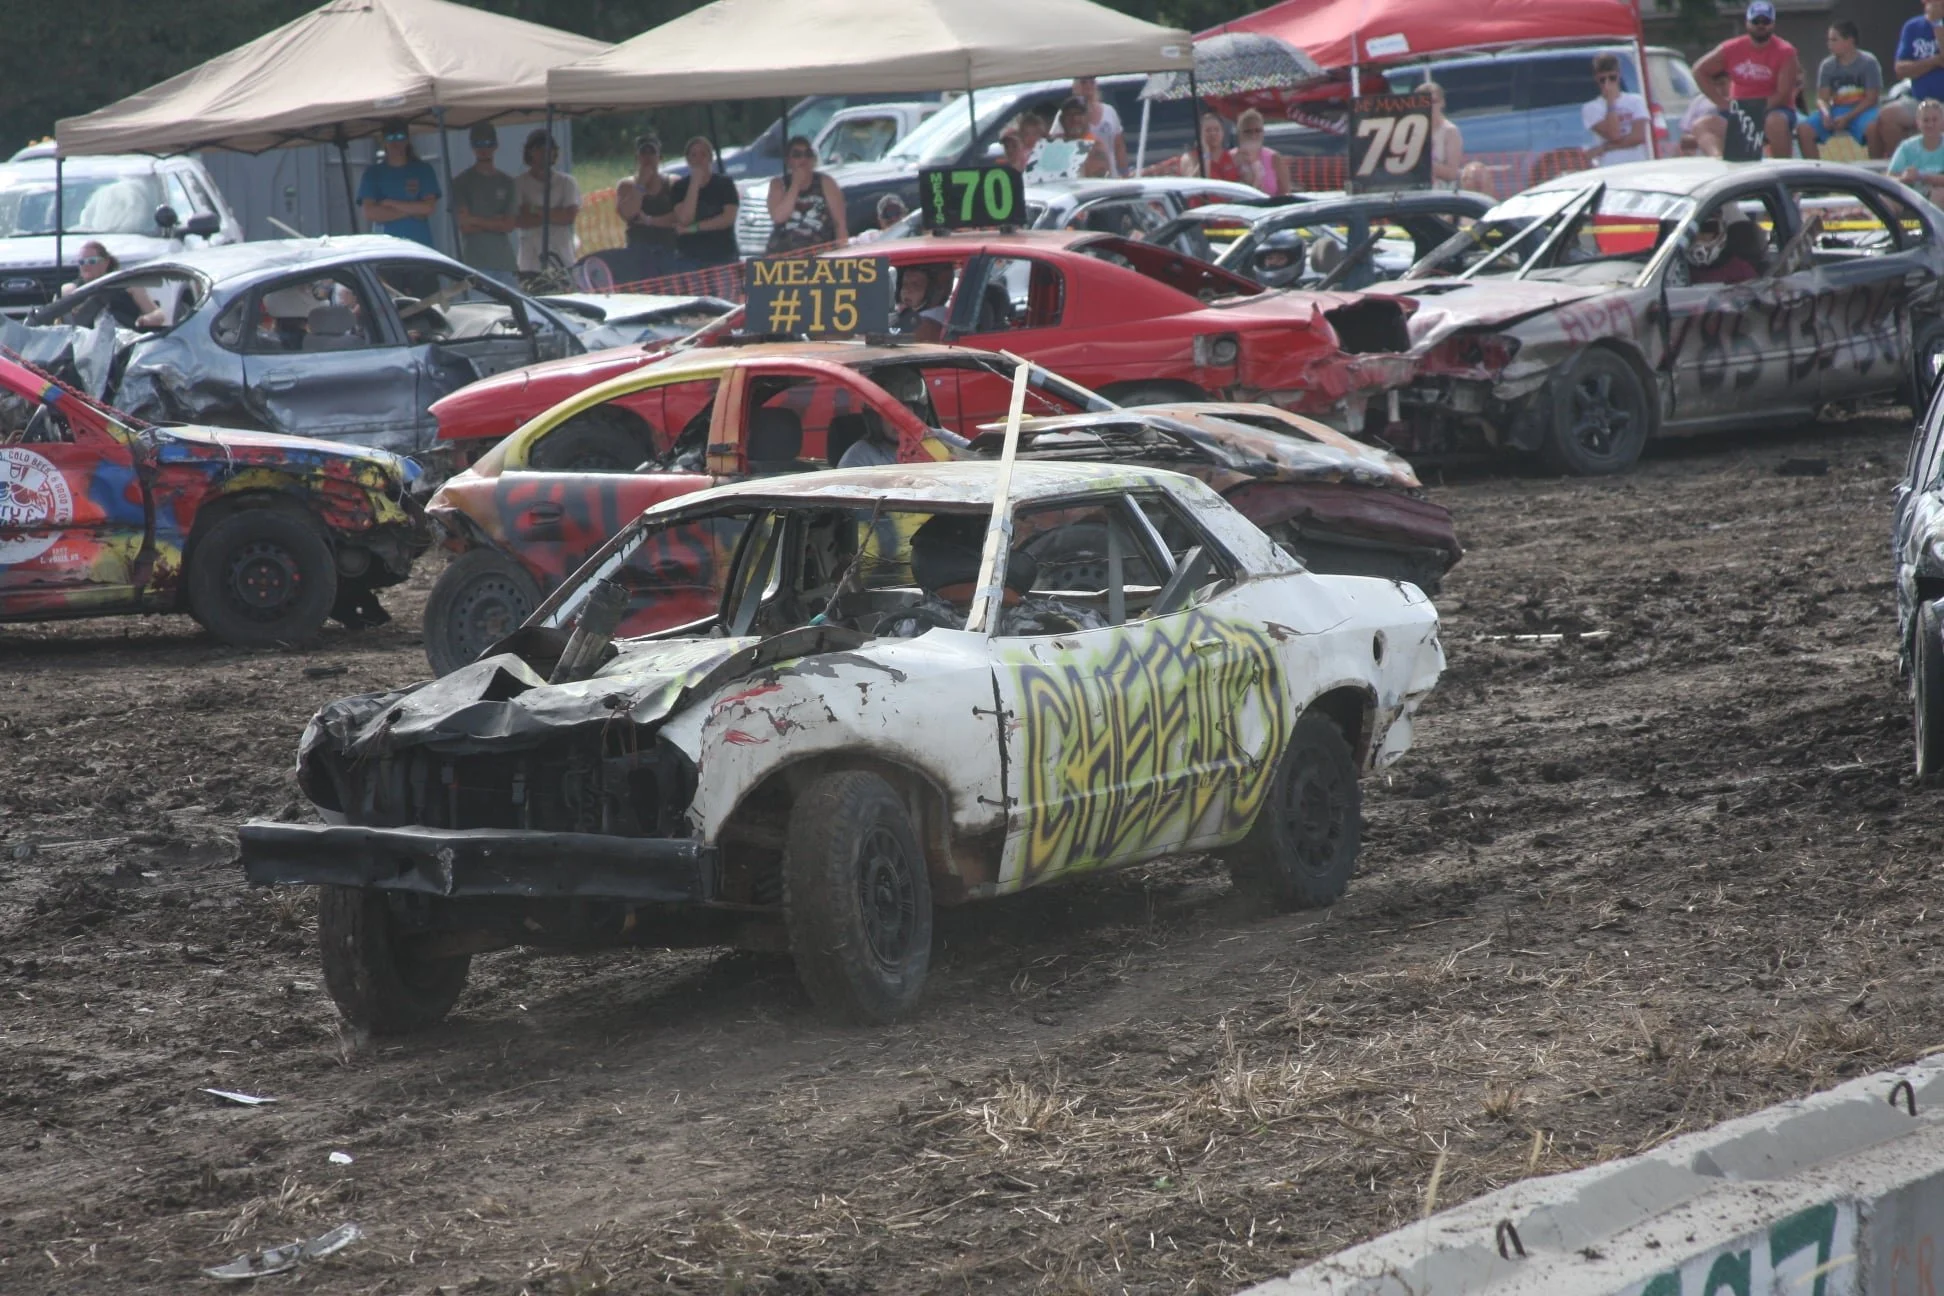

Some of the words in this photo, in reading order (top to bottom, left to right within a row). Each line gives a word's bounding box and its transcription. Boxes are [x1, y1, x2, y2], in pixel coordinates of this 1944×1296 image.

[1356, 113, 1429, 176] 79
[930, 171, 945, 224] MEATS
[951, 168, 1013, 221] 70
[752, 258, 878, 286] MEATS
[768, 288, 859, 333] #15
